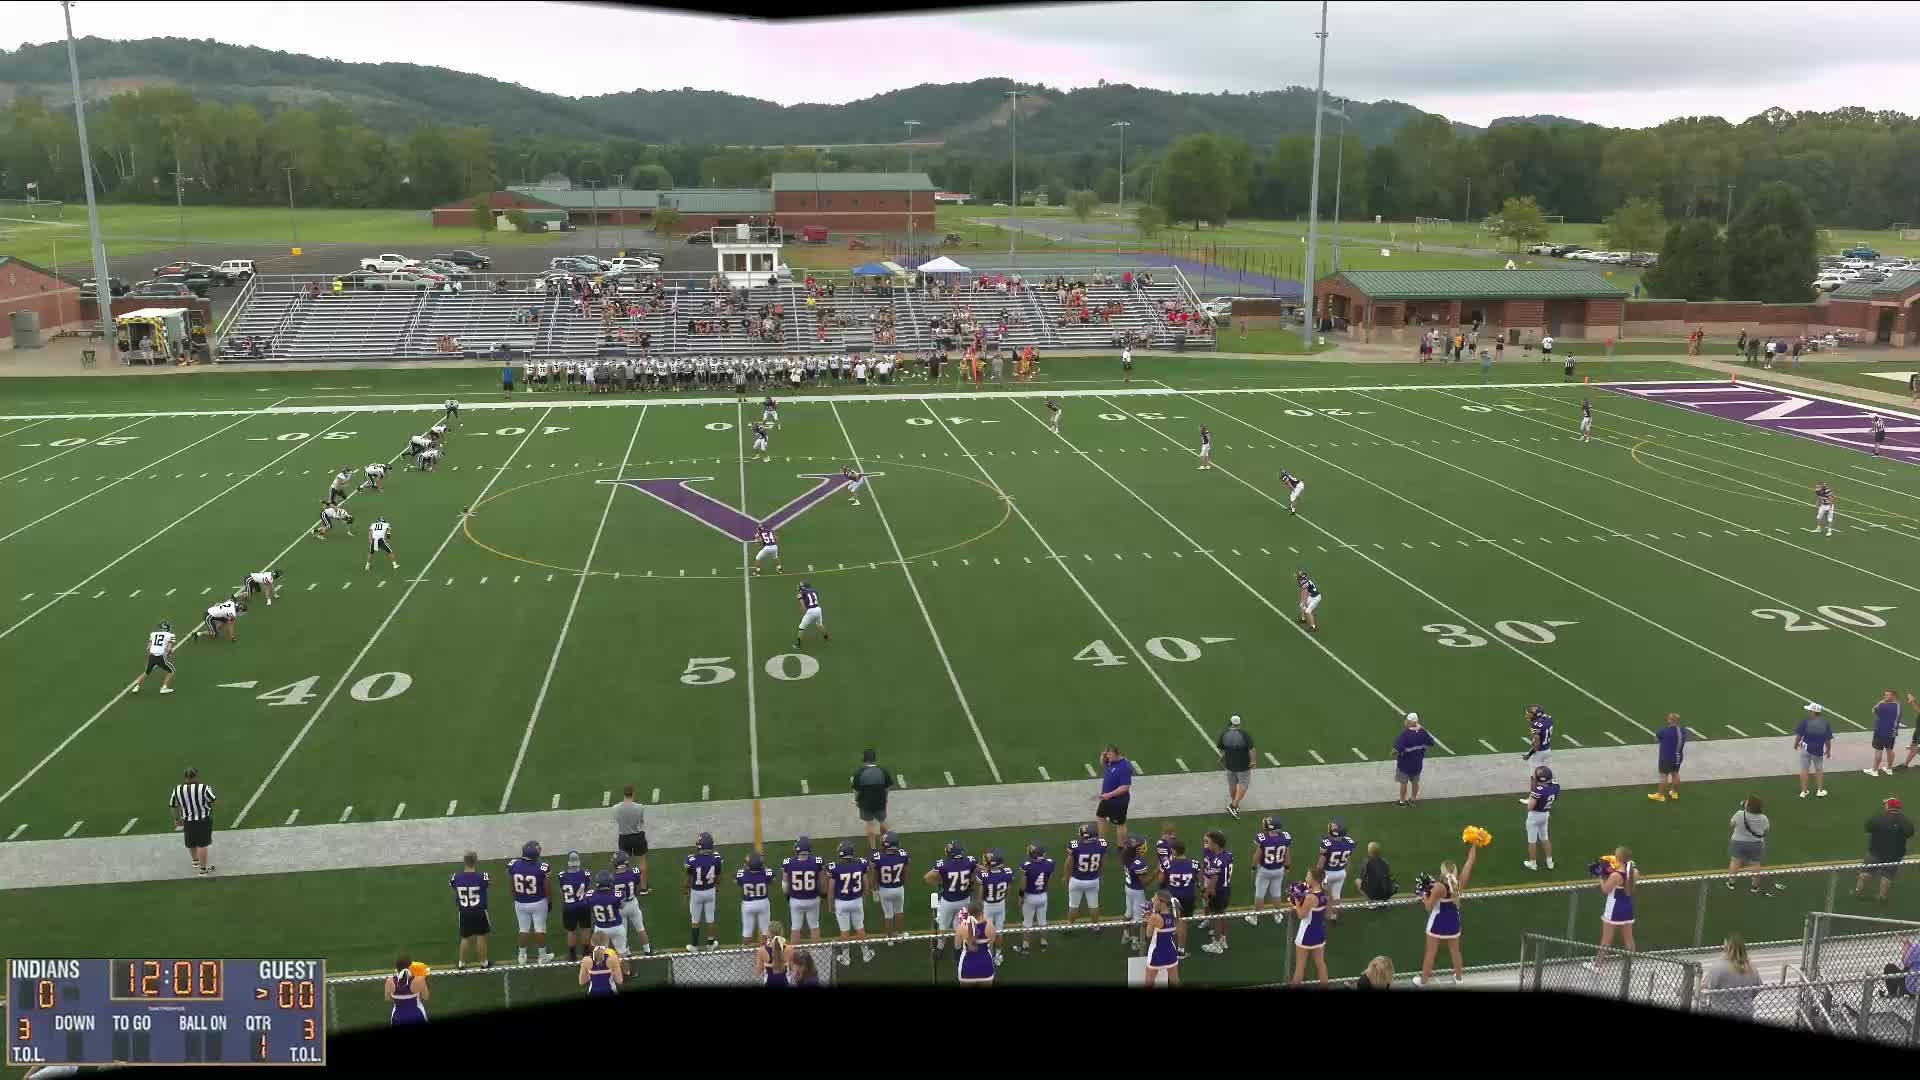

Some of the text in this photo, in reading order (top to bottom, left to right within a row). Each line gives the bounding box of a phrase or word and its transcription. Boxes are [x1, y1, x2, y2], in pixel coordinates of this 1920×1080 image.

[806, 592, 818, 605] 11
[1751, 604, 1887, 632] 20
[152, 633, 164, 646] 12
[1422, 620, 1557, 648] 30
[1073, 636, 1202, 667] 40
[680, 653, 820, 685] 50
[255, 671, 413, 706] 40
[1078, 853, 1101, 872] 58
[1264, 845, 1286, 865] 50
[513, 873, 537, 895] 63
[694, 865, 716, 886] 14
[791, 870, 816, 891] 56
[839, 871, 863, 894] 73
[880, 863, 904, 884] 67
[947, 871, 970, 892] 75
[1034, 872, 1046, 891] 4
[1169, 873, 1193, 888] 57
[457, 886, 481, 908] 55
[987, 881, 1008, 902] 12
